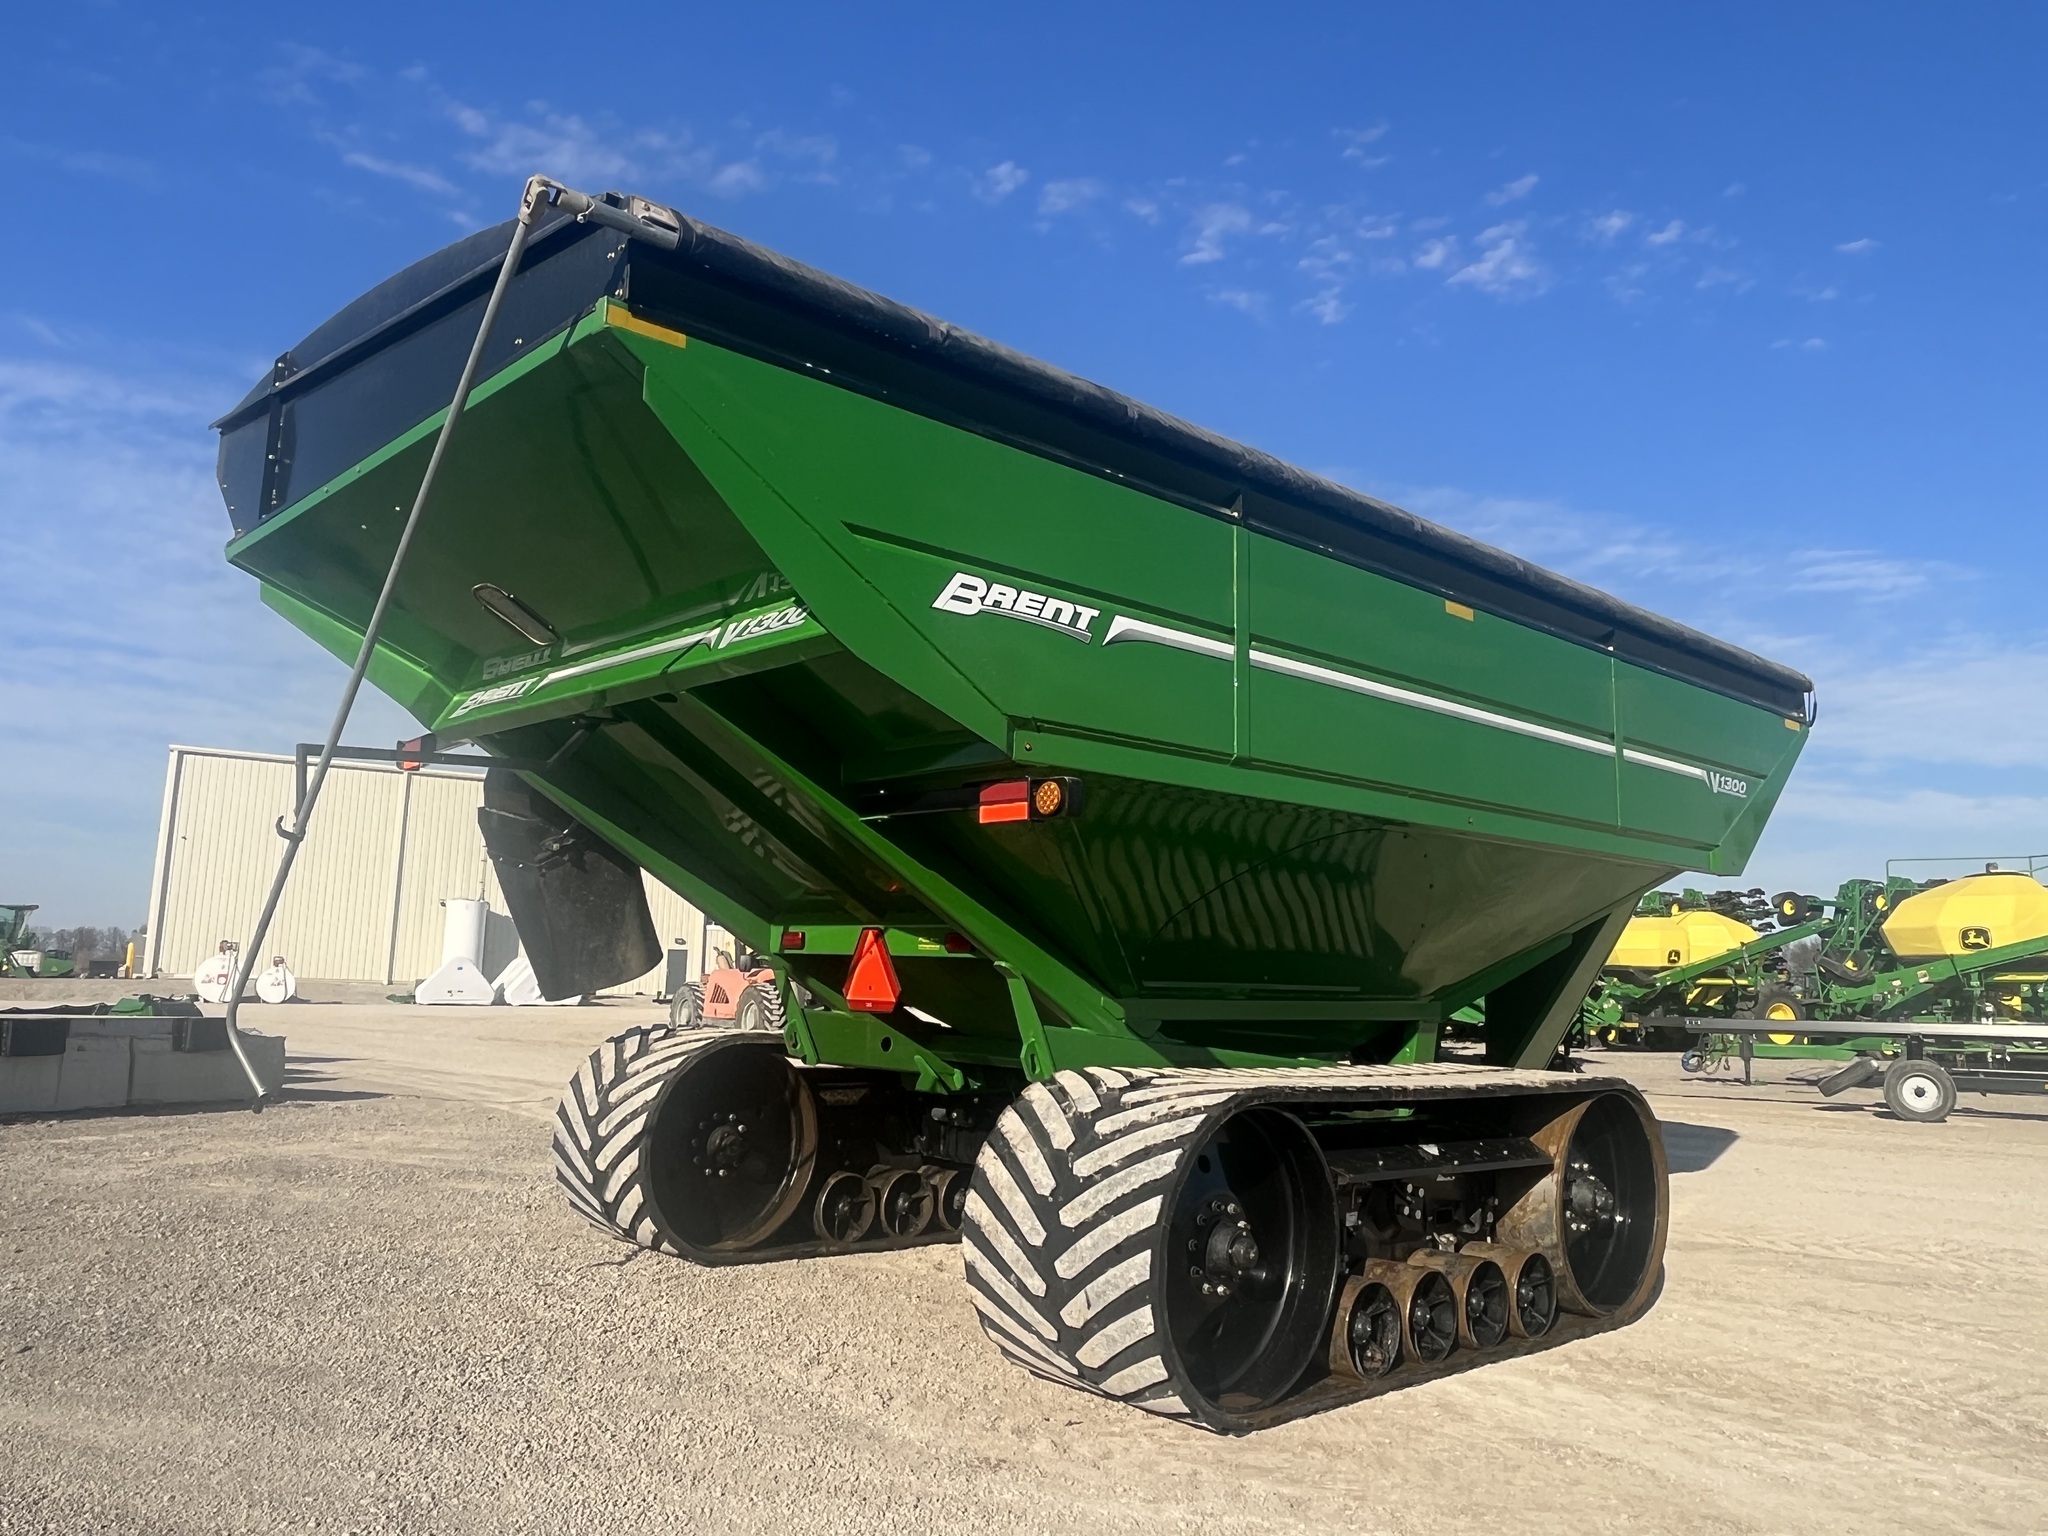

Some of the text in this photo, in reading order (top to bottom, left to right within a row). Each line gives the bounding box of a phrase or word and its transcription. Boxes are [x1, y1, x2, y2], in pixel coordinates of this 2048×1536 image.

[930, 571, 1101, 636] BRENT
[717, 605, 810, 649] V1300
[1709, 771, 1747, 795] V1300
